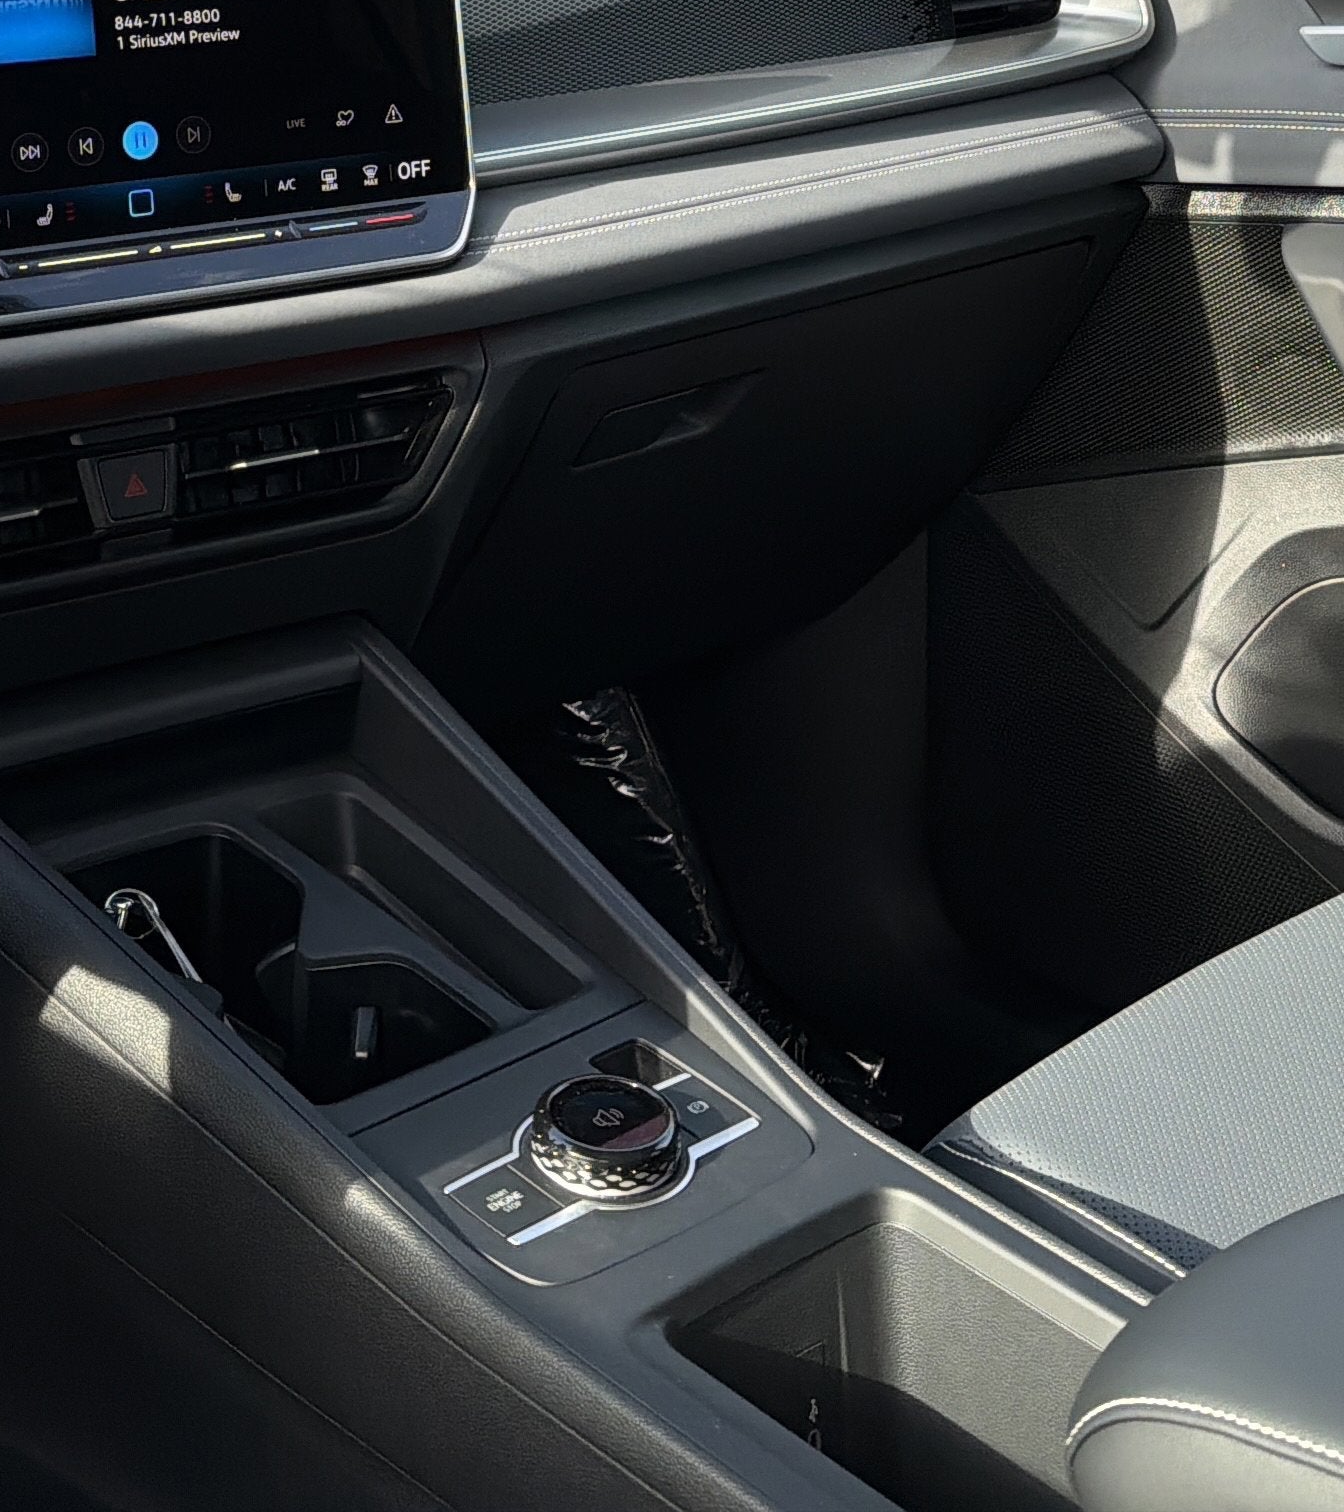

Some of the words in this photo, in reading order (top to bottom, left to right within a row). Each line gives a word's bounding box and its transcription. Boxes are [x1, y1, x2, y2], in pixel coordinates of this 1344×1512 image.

[114, 8, 221, 31] 844-711-8800
[117, 36, 125, 51] 1
[129, 31, 186, 50] SiriusXM
[189, 27, 241, 44] Preview
[286, 118, 306, 129] LIVE
[397, 159, 432, 180] OFF
[277, 177, 297, 192] A/C
[321, 182, 339, 192] REAR
[363, 178, 379, 187] MAX
[486, 1188, 510, 1202] START
[487, 1190, 525, 1212] ENGINE
[503, 1200, 522, 1213] STOP
